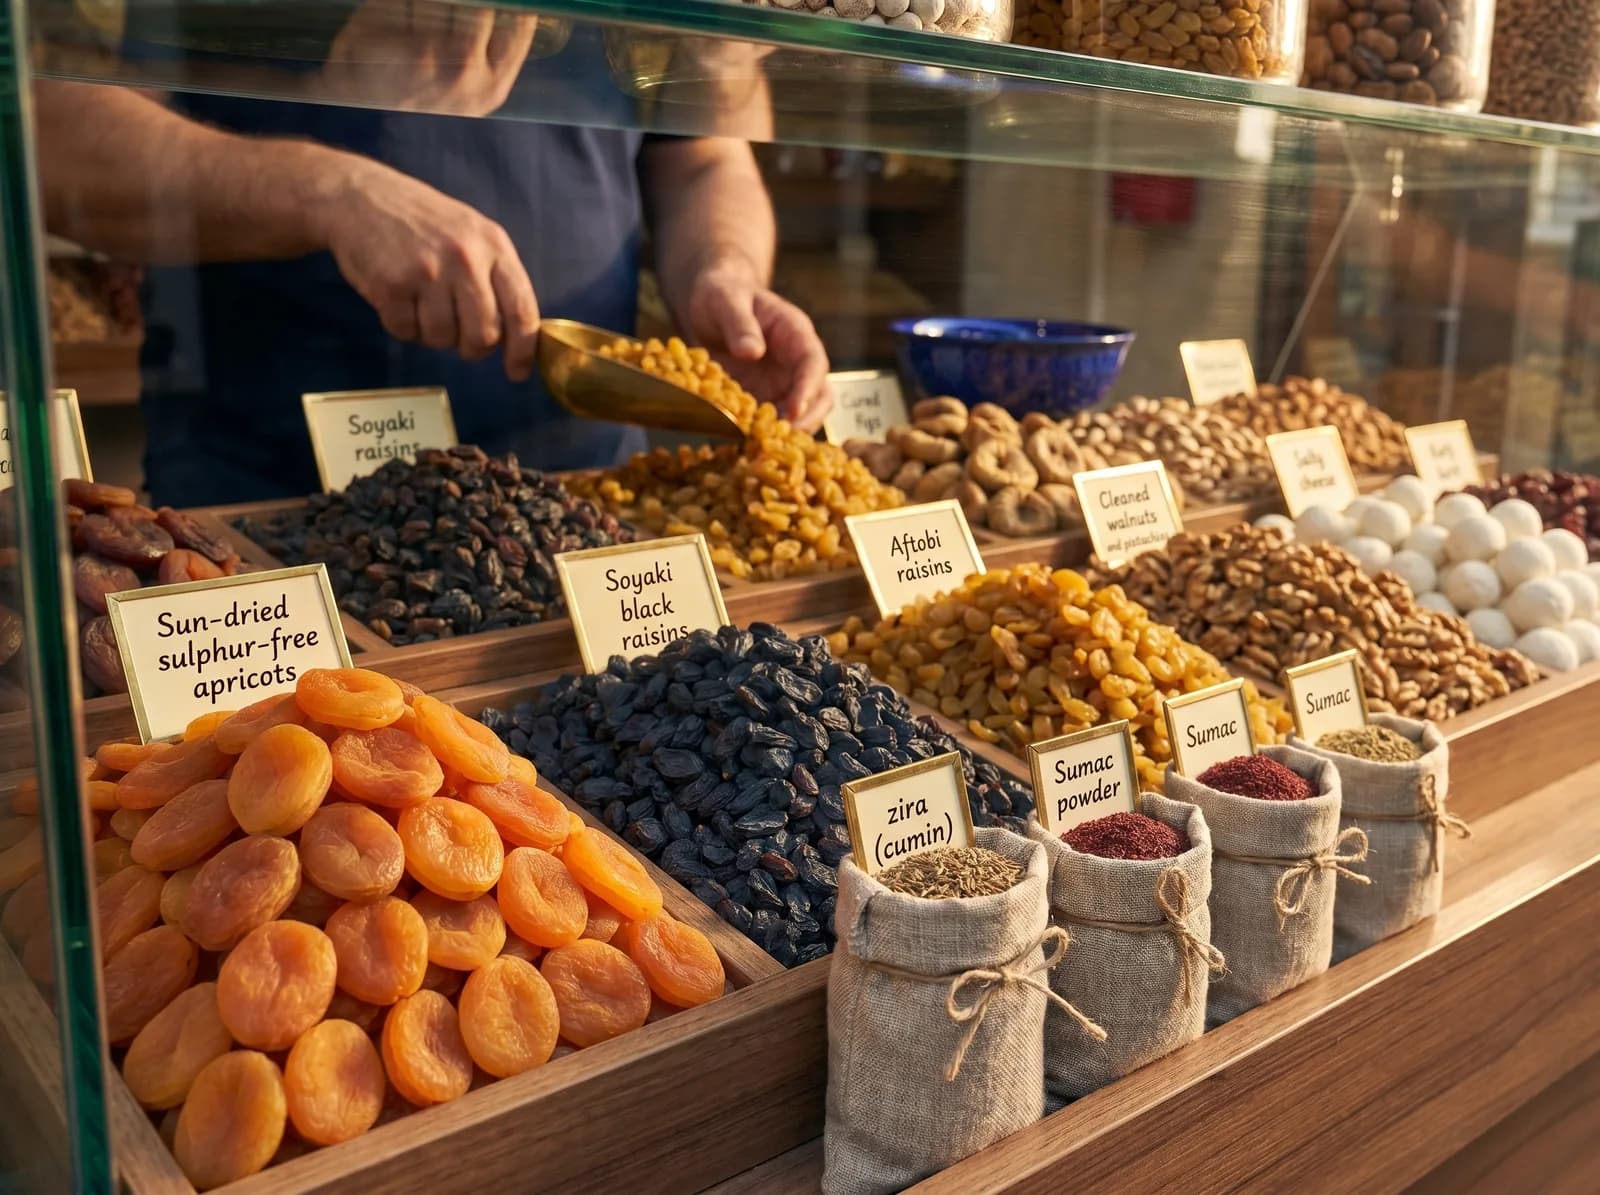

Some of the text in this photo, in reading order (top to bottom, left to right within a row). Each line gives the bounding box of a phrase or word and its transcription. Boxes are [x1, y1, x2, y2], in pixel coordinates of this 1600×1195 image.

[348, 411, 415, 439] Soyaki
[1099, 483, 1150, 509] Cleaned
[1107, 510, 1157, 531] walnuts
[891, 529, 941, 561] Aftobi
[605, 561, 673, 595] Soyaki
[897, 558, 953, 583] raisins
[157, 593, 289, 638] Sun-dried
[621, 592, 675, 622] black
[158, 627, 319, 674] sulphur-free
[622, 624, 689, 650] raisins
[193, 664, 297, 704] apricots
[1306, 688, 1352, 715] Sumac
[1186, 720, 1238, 749] Sumac
[1055, 754, 1114, 785] Sumac
[887, 798, 928, 825] zira
[1057, 777, 1121, 822] powder
[875, 812, 953, 867] (cumin)
